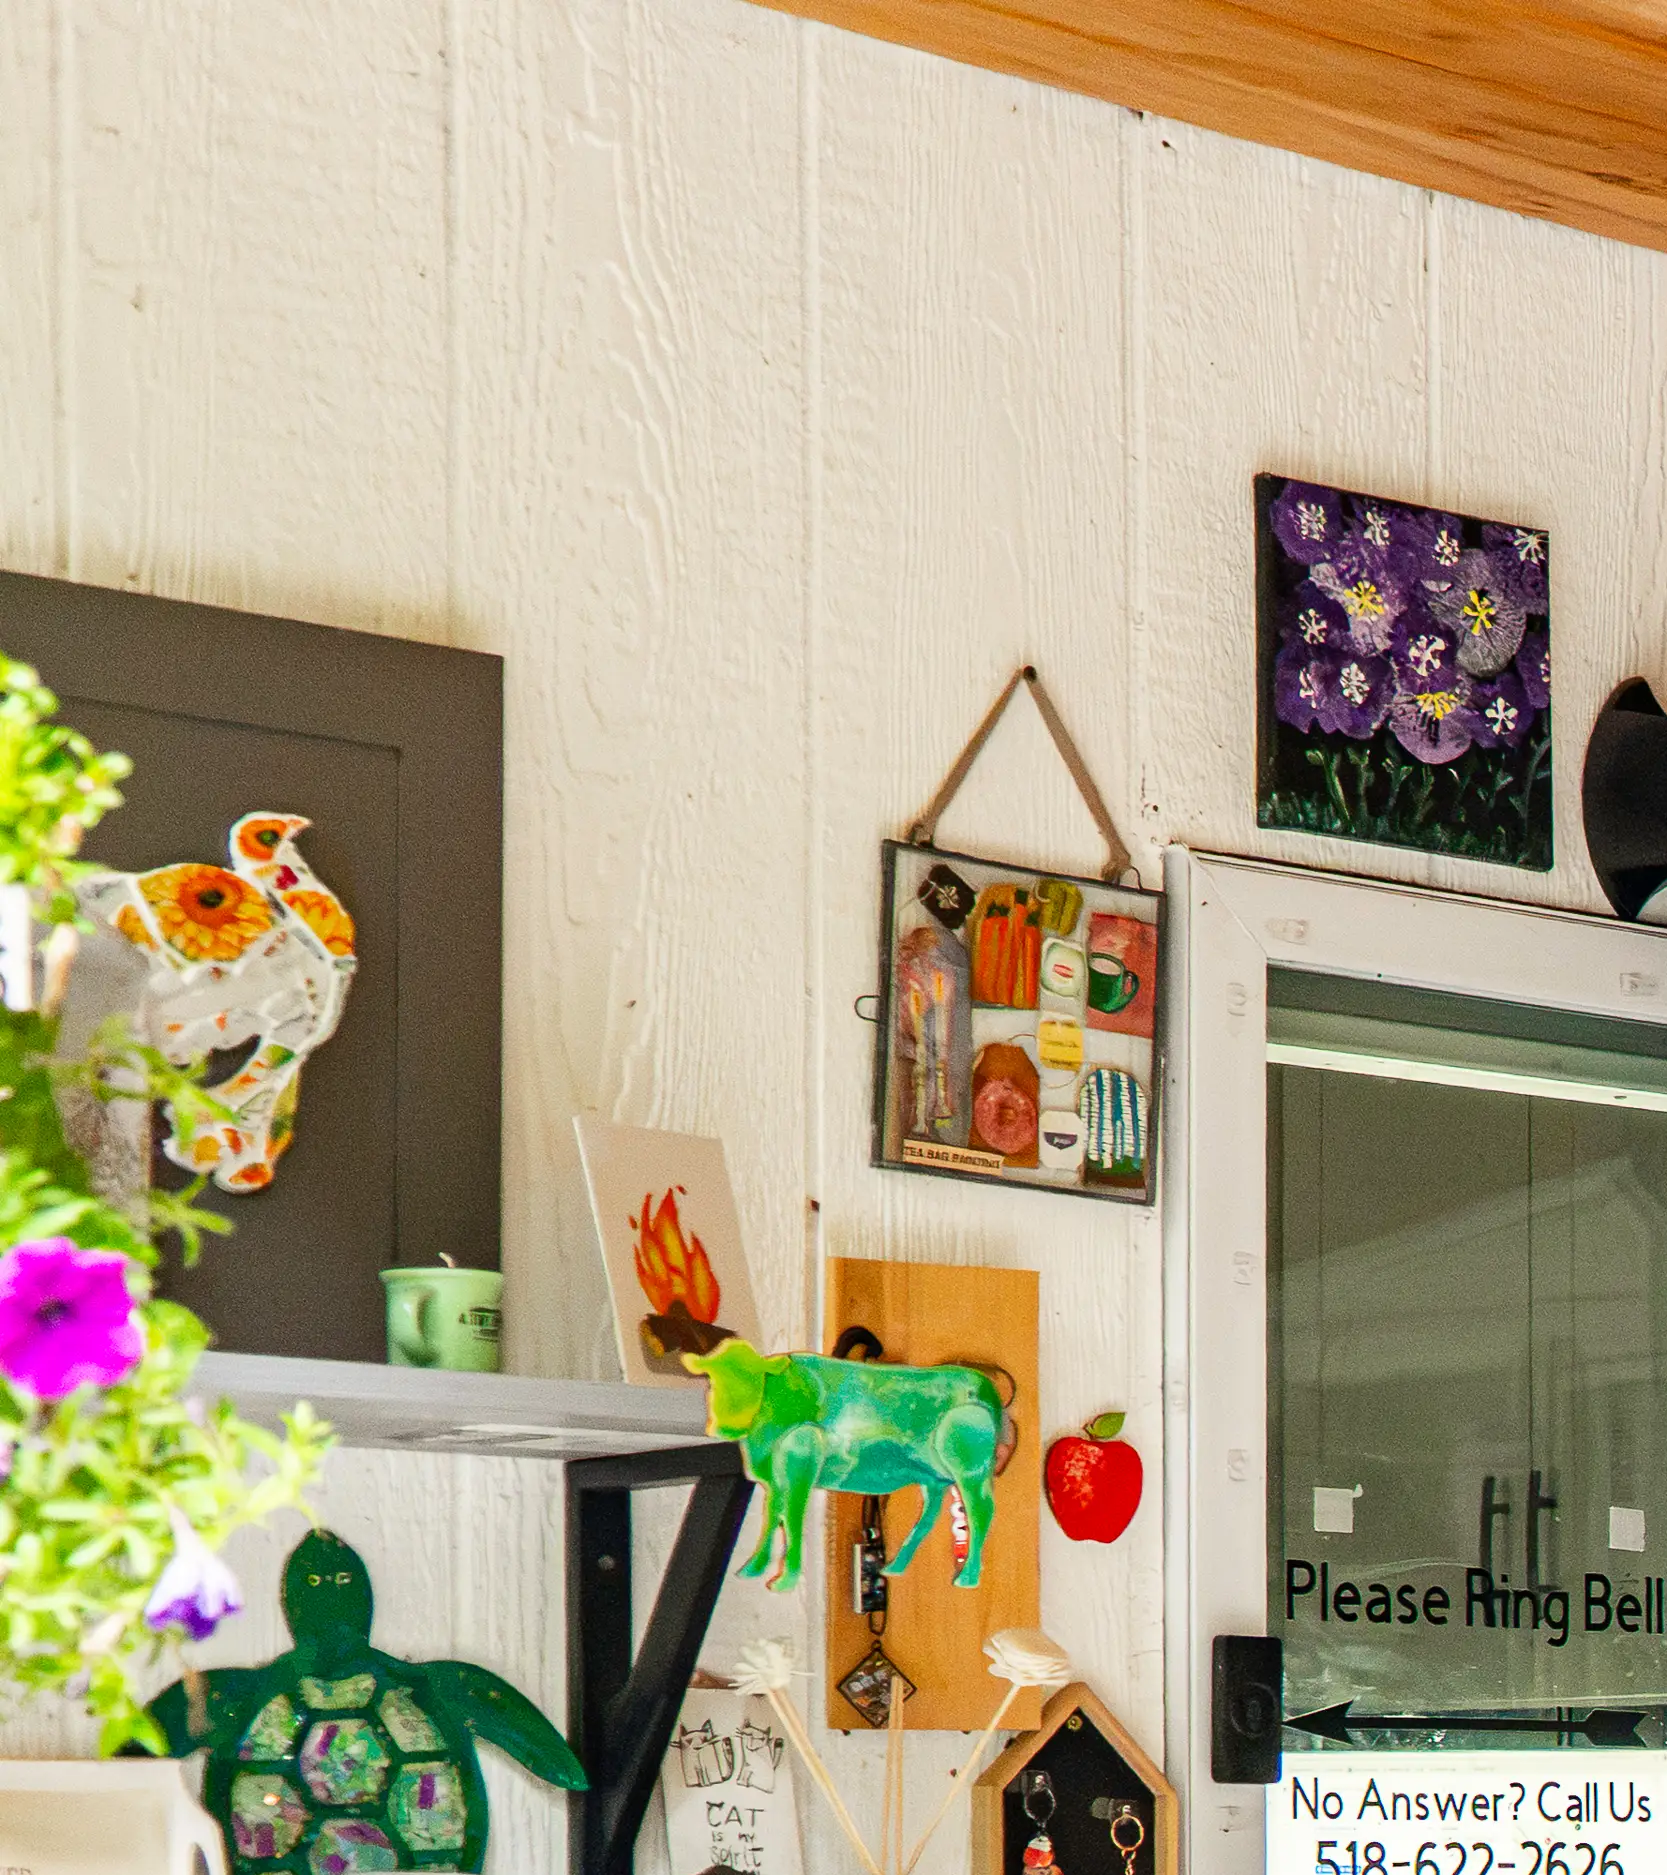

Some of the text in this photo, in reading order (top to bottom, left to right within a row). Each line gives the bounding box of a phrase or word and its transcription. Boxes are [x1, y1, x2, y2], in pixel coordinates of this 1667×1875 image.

[1285, 1559, 1666, 1648] Please Ring Bell
[706, 1801, 765, 1828] CAT
[1291, 1777, 1652, 1823] No Answer? Call Us
